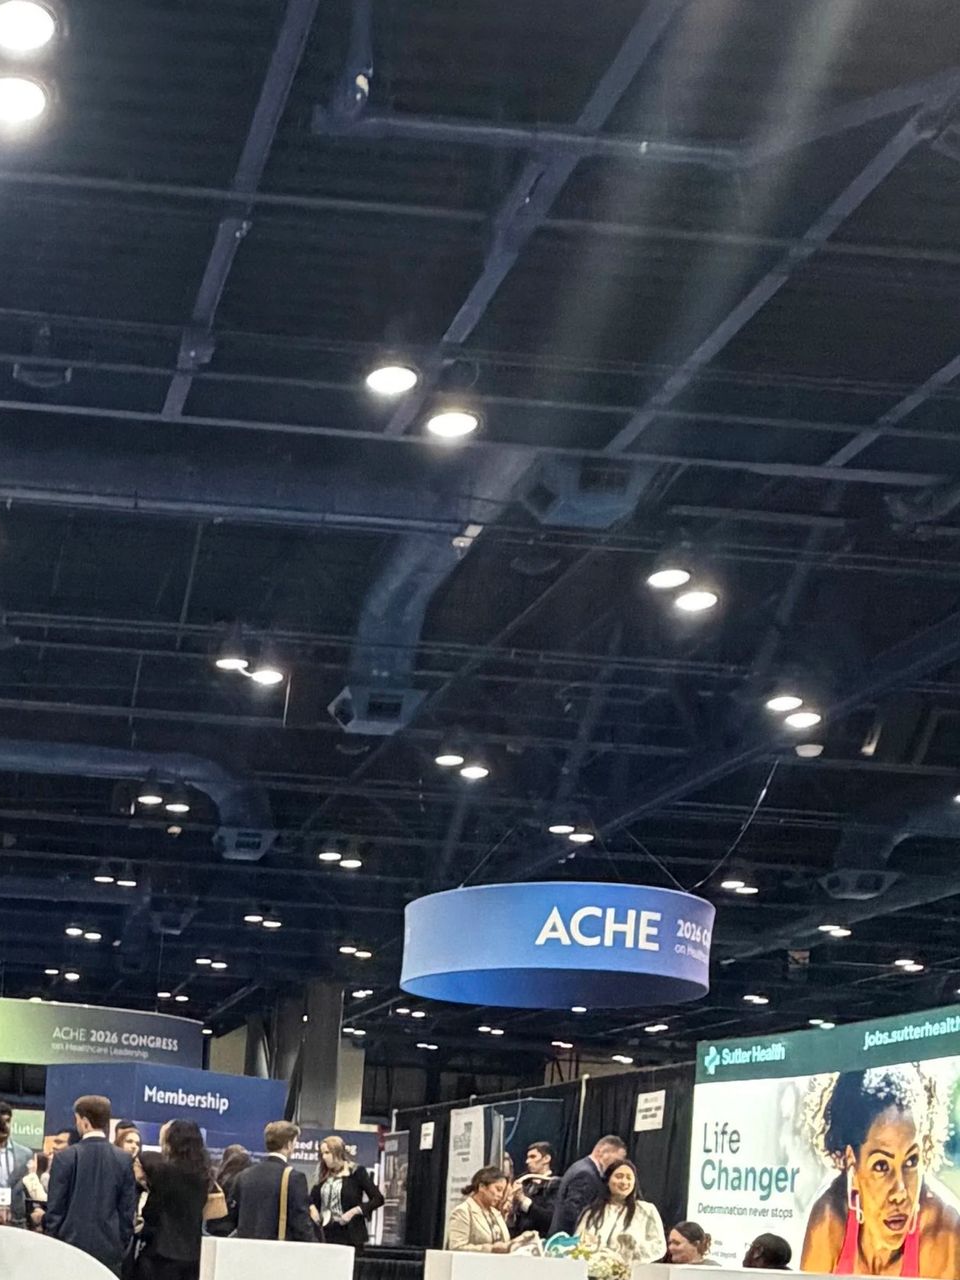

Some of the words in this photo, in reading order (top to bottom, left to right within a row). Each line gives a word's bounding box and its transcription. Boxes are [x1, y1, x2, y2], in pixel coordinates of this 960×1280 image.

[535, 905, 662, 951] ACHE
[676, 918, 702, 943] 2026
[52, 1026, 88, 1041] ACHE
[90, 1029, 119, 1044] 2026
[121, 1033, 179, 1051] CONGRESS
[751, 1042, 786, 1062] Health
[144, 1084, 229, 1115] Membership
[703, 1121, 741, 1154] Life
[700, 1158, 800, 1201] Changer
[698, 1202, 748, 1216] Determination
[749, 1207, 770, 1218] never
[771, 1207, 793, 1220] stops
